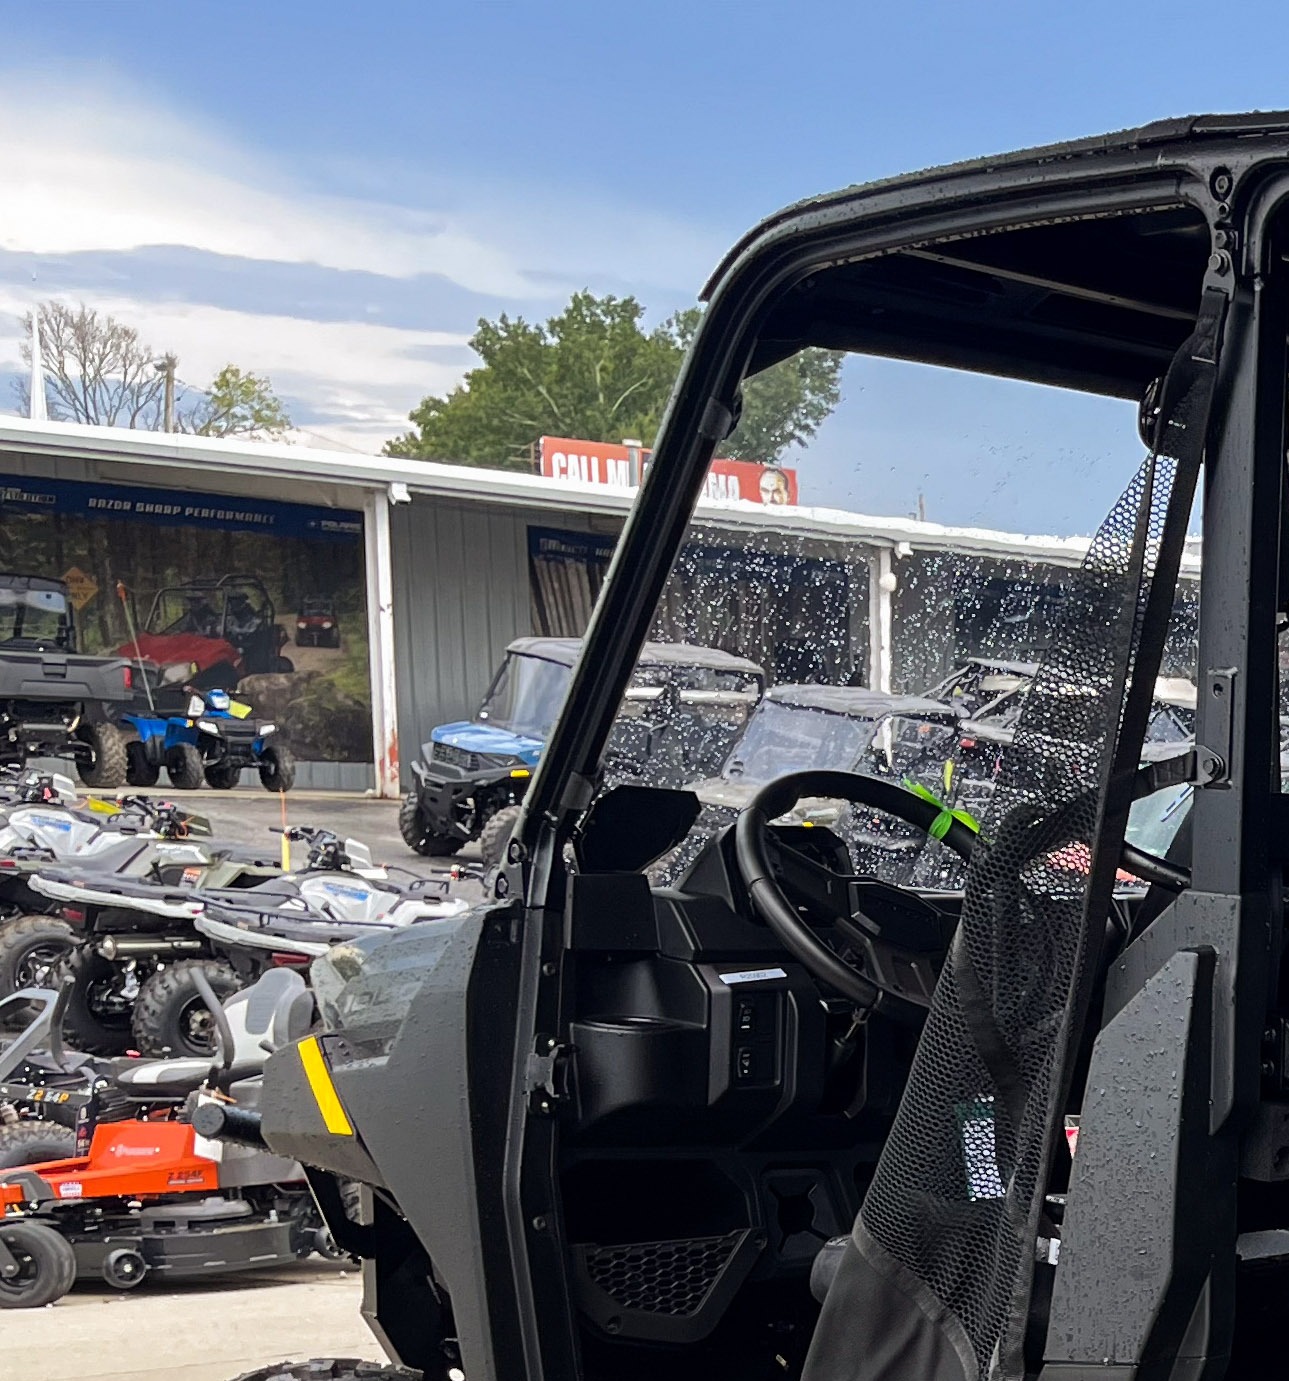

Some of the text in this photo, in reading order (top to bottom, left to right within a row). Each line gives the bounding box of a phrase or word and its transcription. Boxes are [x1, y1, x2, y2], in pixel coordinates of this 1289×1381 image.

[88, 497, 276, 525] RAZOR SHARP PERFORMANCE
